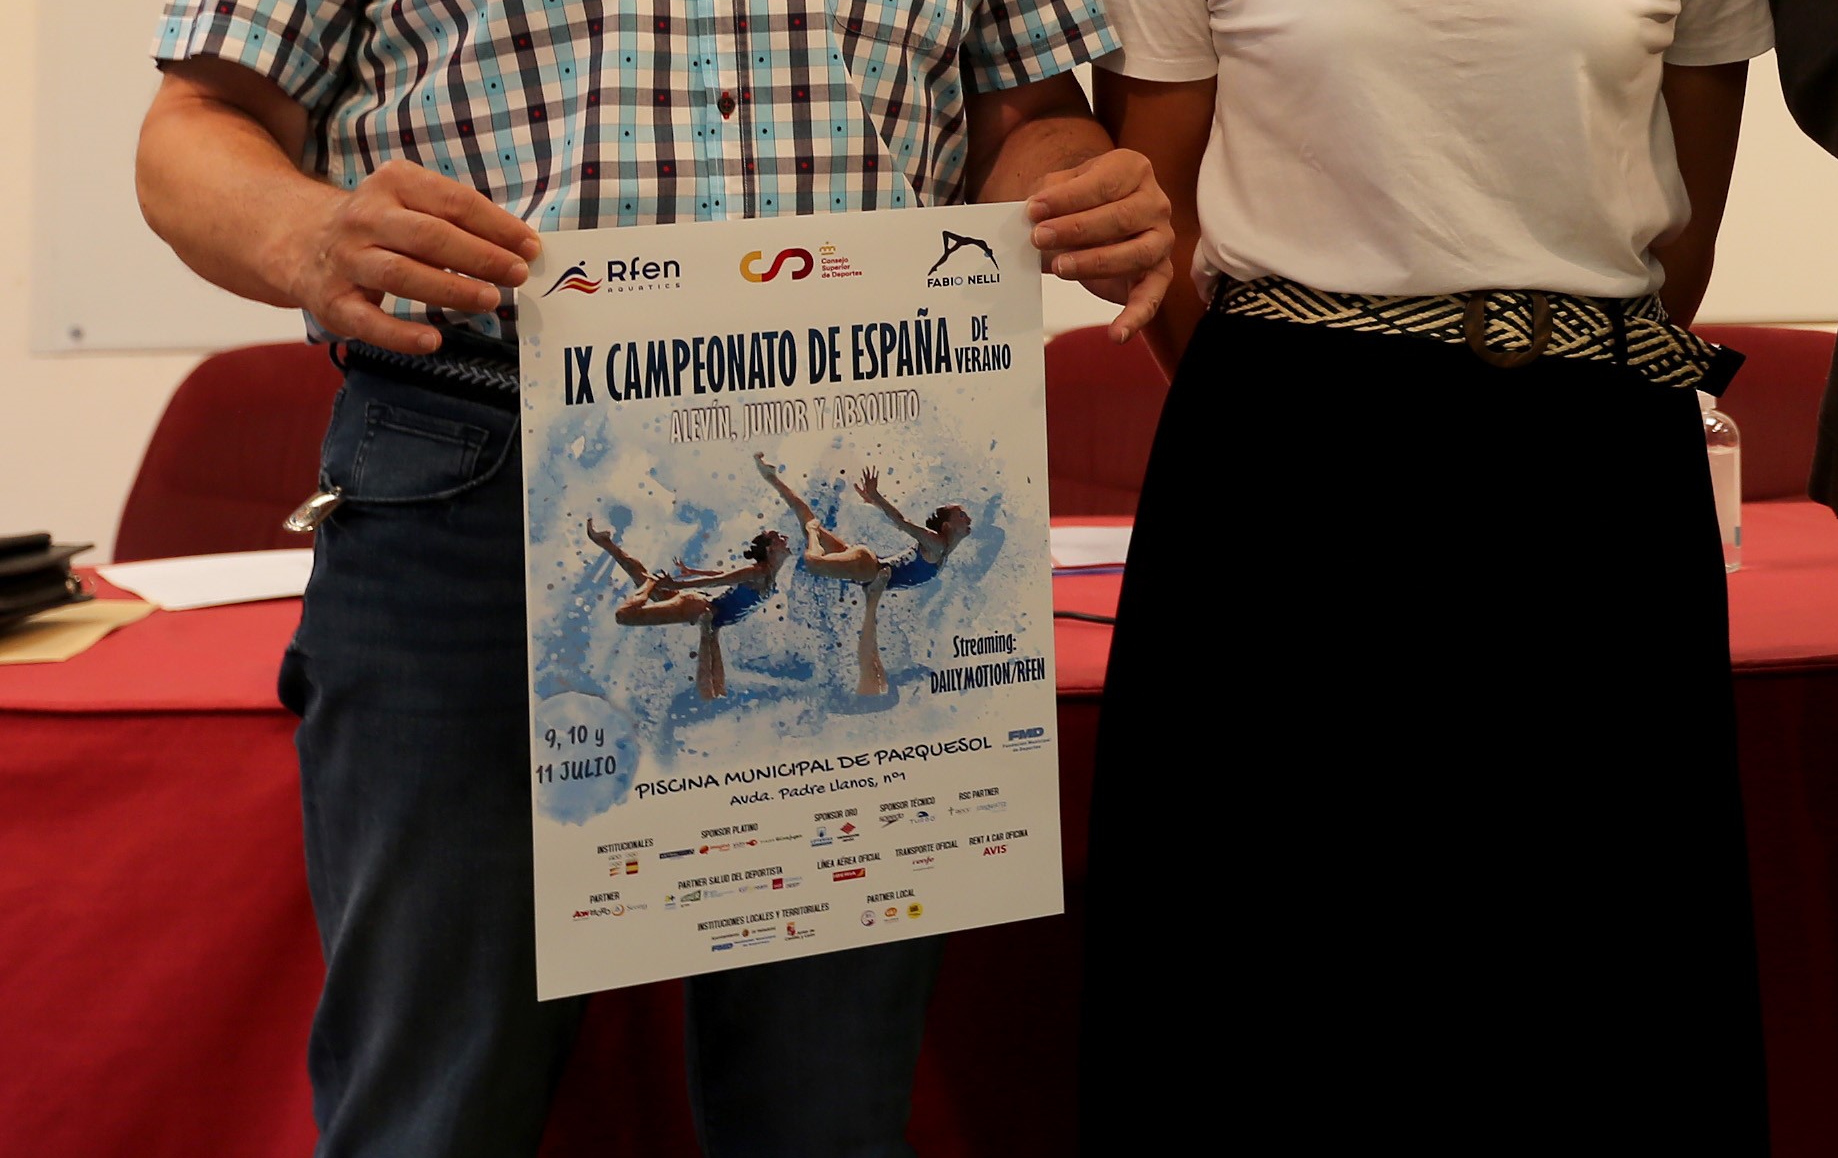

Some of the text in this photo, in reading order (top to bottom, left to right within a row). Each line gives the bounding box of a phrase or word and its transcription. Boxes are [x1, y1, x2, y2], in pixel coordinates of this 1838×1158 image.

[607, 256, 681, 282] Rfen
[821, 257, 849, 267] Consejo
[821, 262, 851, 272] Superior
[831, 269, 862, 279] Deportes
[927, 273, 1000, 288] FABIO NELLI
[607, 282, 681, 293] AQUATICS
[564, 307, 989, 406] IX CAMPEONATO DE ESPAÑA DE
[954, 343, 1012, 374] VERANO
[670, 389, 920, 444] ALEVÍN, JUNIOR Y ABSOLUTO
[953, 630, 1017, 658] Streaming:
[930, 657, 1046, 694] DAILYMOTION/RFEN
[544, 725, 604, 749] 9, 10 y
[1008, 727, 1045, 741] FMD
[535, 756, 616, 784] 11 JULIO
[635, 775, 720, 799] PISCINA
[724, 759, 834, 787] MUNICIPAL
[837, 753, 870, 770] DE
[874, 736, 992, 766] PARQUESOL
[729, 790, 774, 806] Avda.
[778, 783, 826, 800] Padre
[829, 777, 879, 793] Llanos,
[972, 787, 999, 799] PARTNER
[880, 800, 908, 812] SPONSOR
[814, 809, 844, 822] SPONSOR
[700, 823, 759, 839] SPONSOR PLATINO
[597, 838, 654, 854] INSTITUCIONALES
[895, 844, 935, 858] TRANSPORTE
[983, 844, 1007, 857] AVIS
[678, 866, 784, 890] PARTNER SALUD DEL DEPORTISTA
[589, 892, 620, 904] PARTNER
[867, 888, 915, 904] PARTNER LOCAL
[697, 916, 745, 931] INSTITUCIONES
[746, 911, 774, 924] LOCALES
[782, 902, 830, 918] TERRITORIALES
